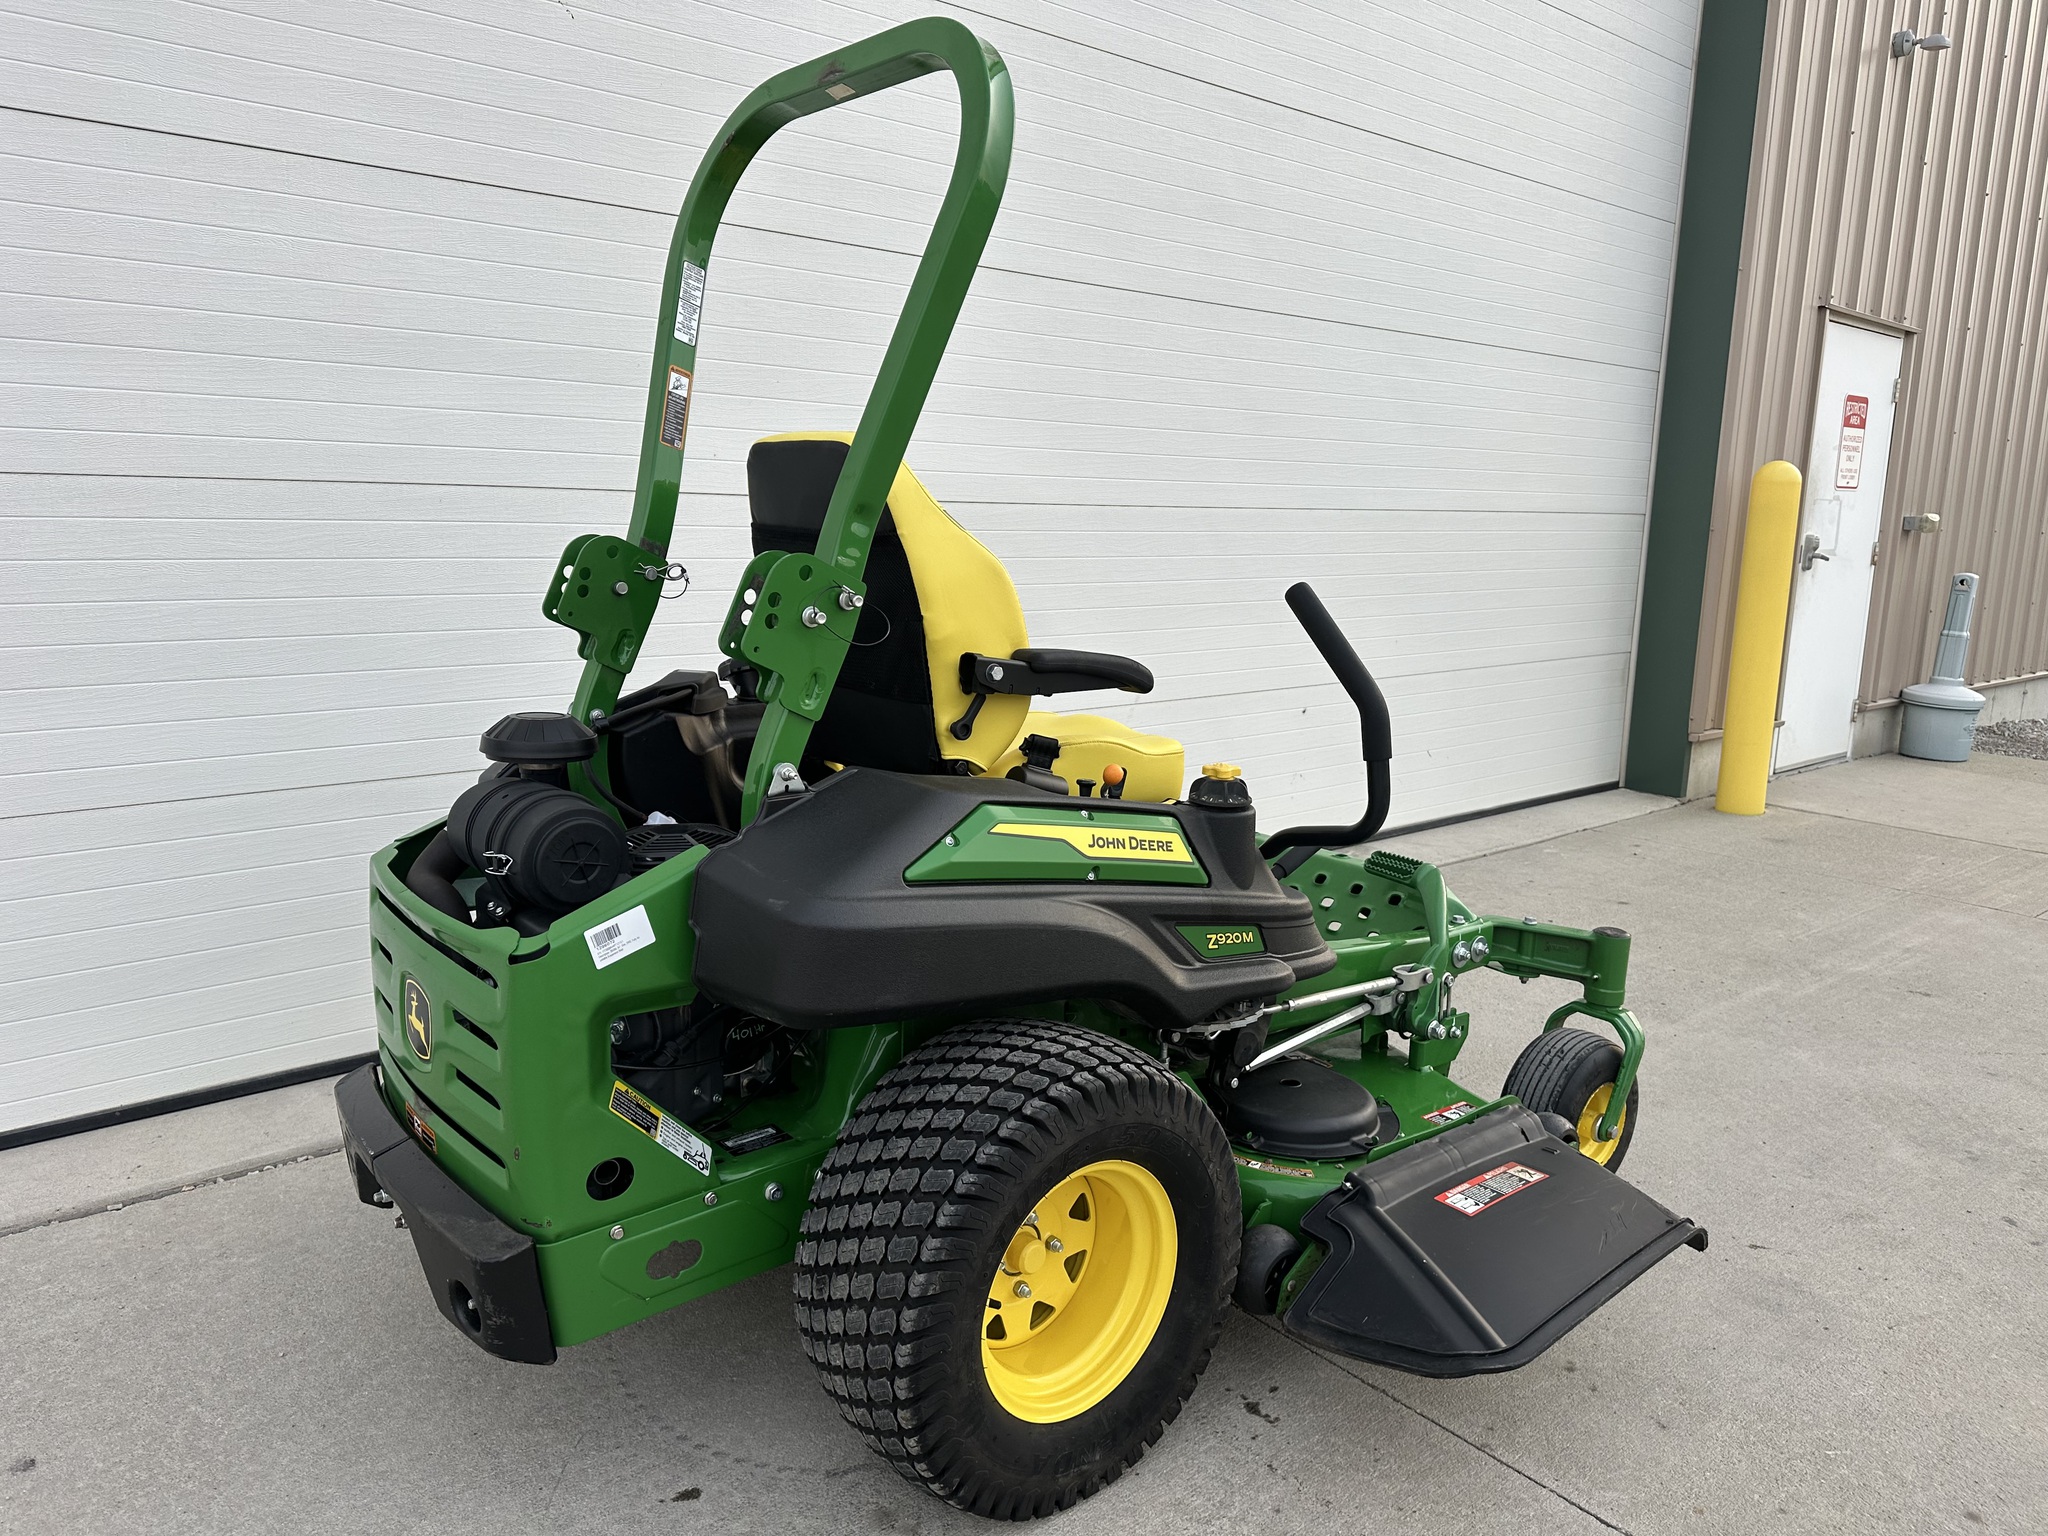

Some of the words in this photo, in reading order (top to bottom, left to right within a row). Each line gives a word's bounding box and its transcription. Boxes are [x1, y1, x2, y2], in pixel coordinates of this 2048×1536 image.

[1849, 416, 1860, 425] AREA
[1843, 445, 1860, 453] PERSONNEL
[1088, 833, 1127, 851] JOHN
[1129, 835, 1174, 853] DEERE
[1206, 931, 1255, 951] Z920M
[731, 1026, 754, 1042] 401
[629, 1090, 652, 1111] CAUTION
